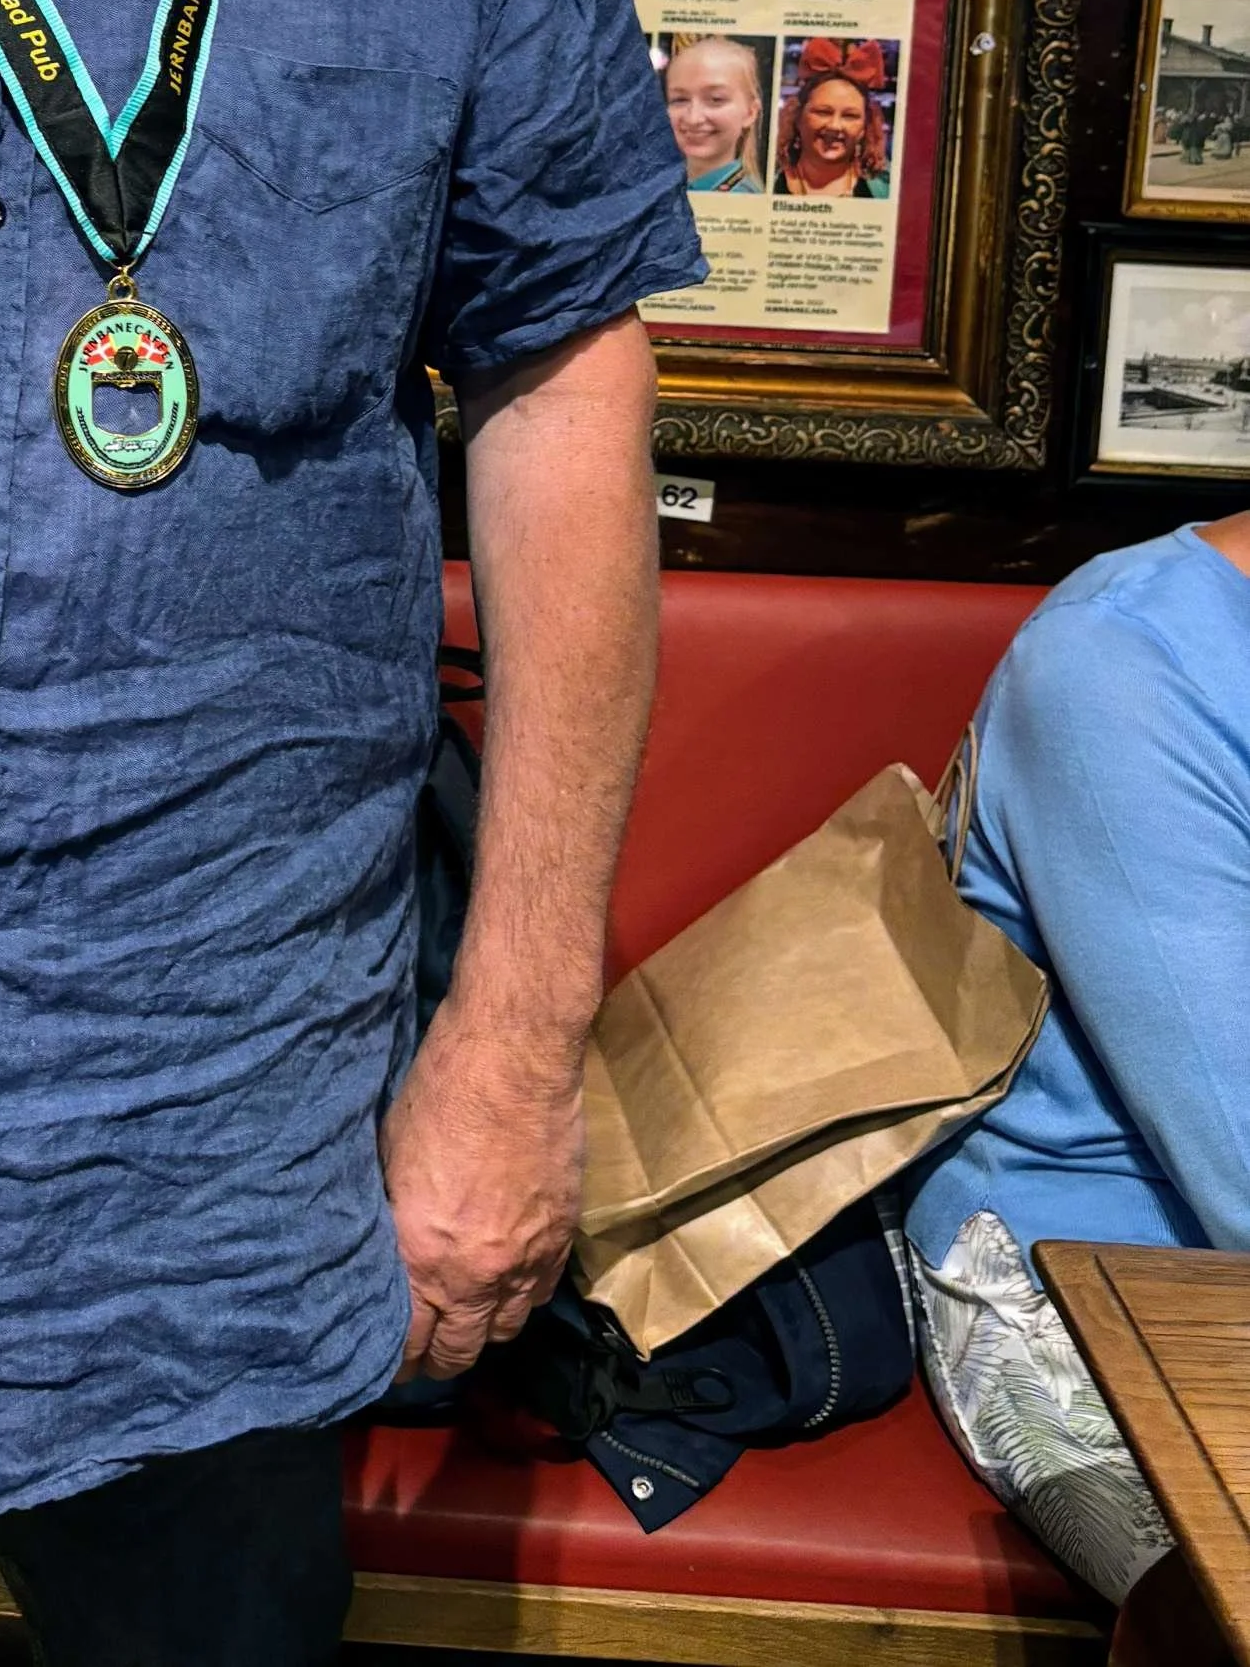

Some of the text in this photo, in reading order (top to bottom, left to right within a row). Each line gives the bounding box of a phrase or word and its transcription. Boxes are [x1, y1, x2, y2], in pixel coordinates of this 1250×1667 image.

[20, 29, 61, 82] Pub
[772, 201, 833, 214] Elisabeth
[79, 322, 174, 374] JERNBANECAFEEN
[662, 484, 698, 510] 62
